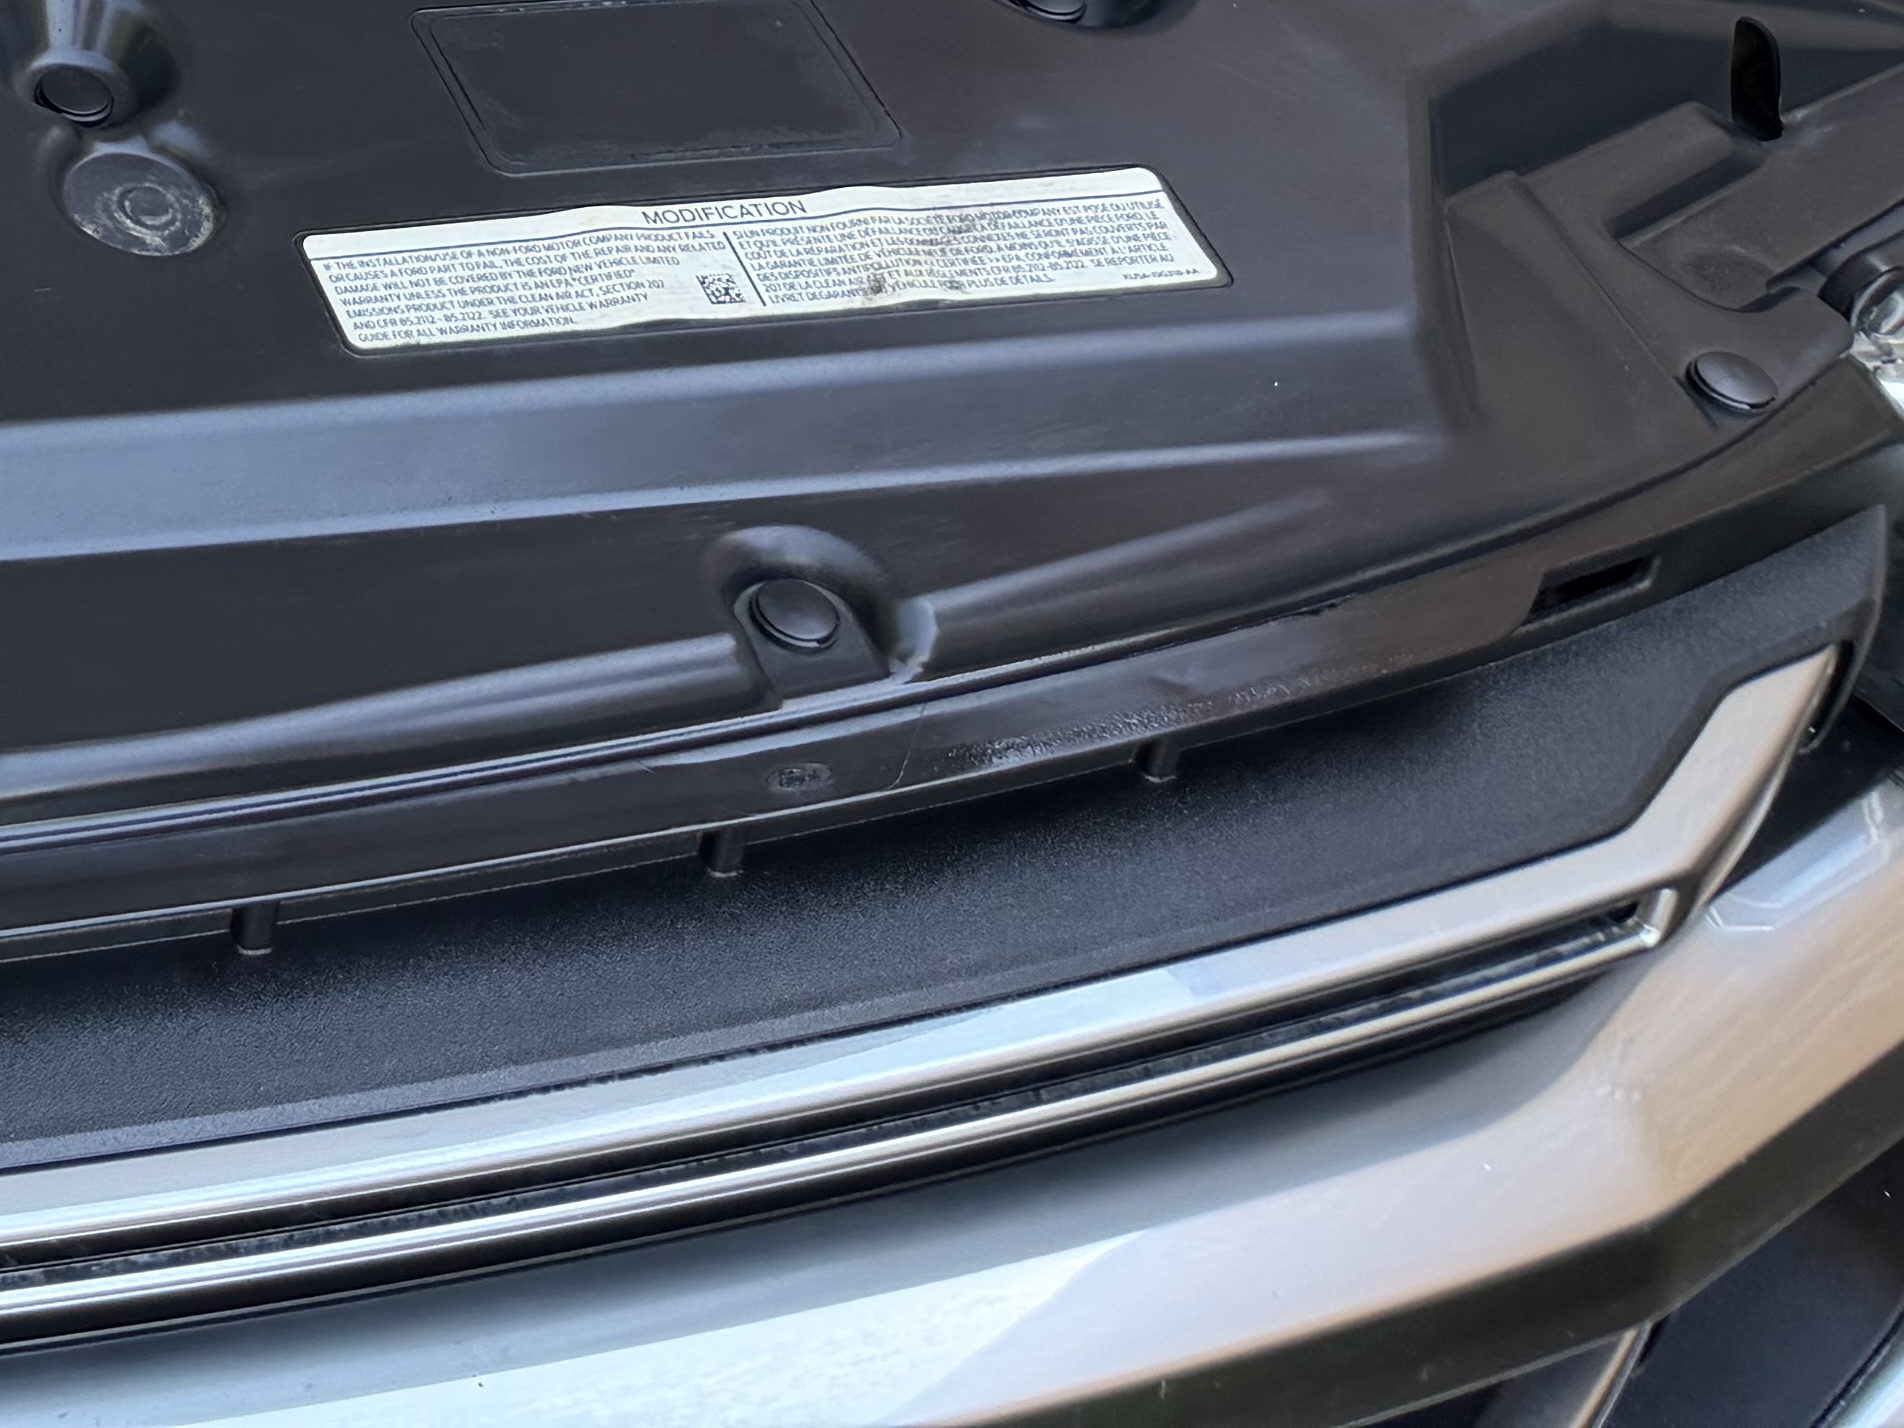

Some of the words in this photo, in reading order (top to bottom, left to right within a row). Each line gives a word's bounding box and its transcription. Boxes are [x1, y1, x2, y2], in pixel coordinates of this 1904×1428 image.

[641, 200, 807, 225] MODIFICATION
[807, 222, 830, 234] NON
[891, 215, 906, 225] LA
[1062, 205, 1081, 215] EST
[336, 260, 358, 270] THE
[459, 250, 476, 261] OF
[477, 250, 485, 259] A
[544, 238, 583, 253] MOTOR
[636, 231, 684, 241] PRODUCT
[345, 269, 388, 282] CAUSES
[390, 268, 398, 278] A
[399, 265, 428, 277] FORD
[429, 263, 457, 274] PART
[459, 262, 473, 272] TO
[504, 257, 523, 268] THE
[524, 253, 554, 266] COST
[556, 252, 569, 262] OF
[570, 249, 592, 261] THE
[594, 245, 634, 258] REPAIR
[635, 244, 656, 254] AND
[656, 243, 677, 253] ANY
[678, 240, 727, 252] RELATED
[857, 251, 872, 262] DE
[410, 277, 431, 288] NOT
[433, 276, 447, 286] BE
[449, 271, 498, 285] COVERED
[499, 269, 515, 280] BY
[538, 264, 567, 276] FORD
[567, 261, 592, 273] NEW
[596, 257, 639, 270] VEHICLE
[340, 292, 402, 307] WARRANTY
[404, 289, 446, 301] UNLESS
[449, 287, 469, 298] THE
[470, 283, 519, 296] PRODUCT
[521, 282, 533, 292] IS
[346, 305, 404, 319] EMISSIONS
[406, 300, 455, 314] PRODUCT
[457, 297, 494, 309] UNDER
[497, 295, 517, 306] THE
[518, 291, 554, 304] CLEAN
[600, 280, 646, 295] SECTION
[353, 320, 375, 331] AND
[491, 308, 510, 319] SEE
[511, 305, 540, 317] YOUR
[542, 300, 584, 314] VEHICLE
[586, 292, 649, 309] WARRANTY
[393, 328, 414, 339] FOR
[416, 327, 437, 337] ALL
[438, 322, 498, 336] WARRANTY
